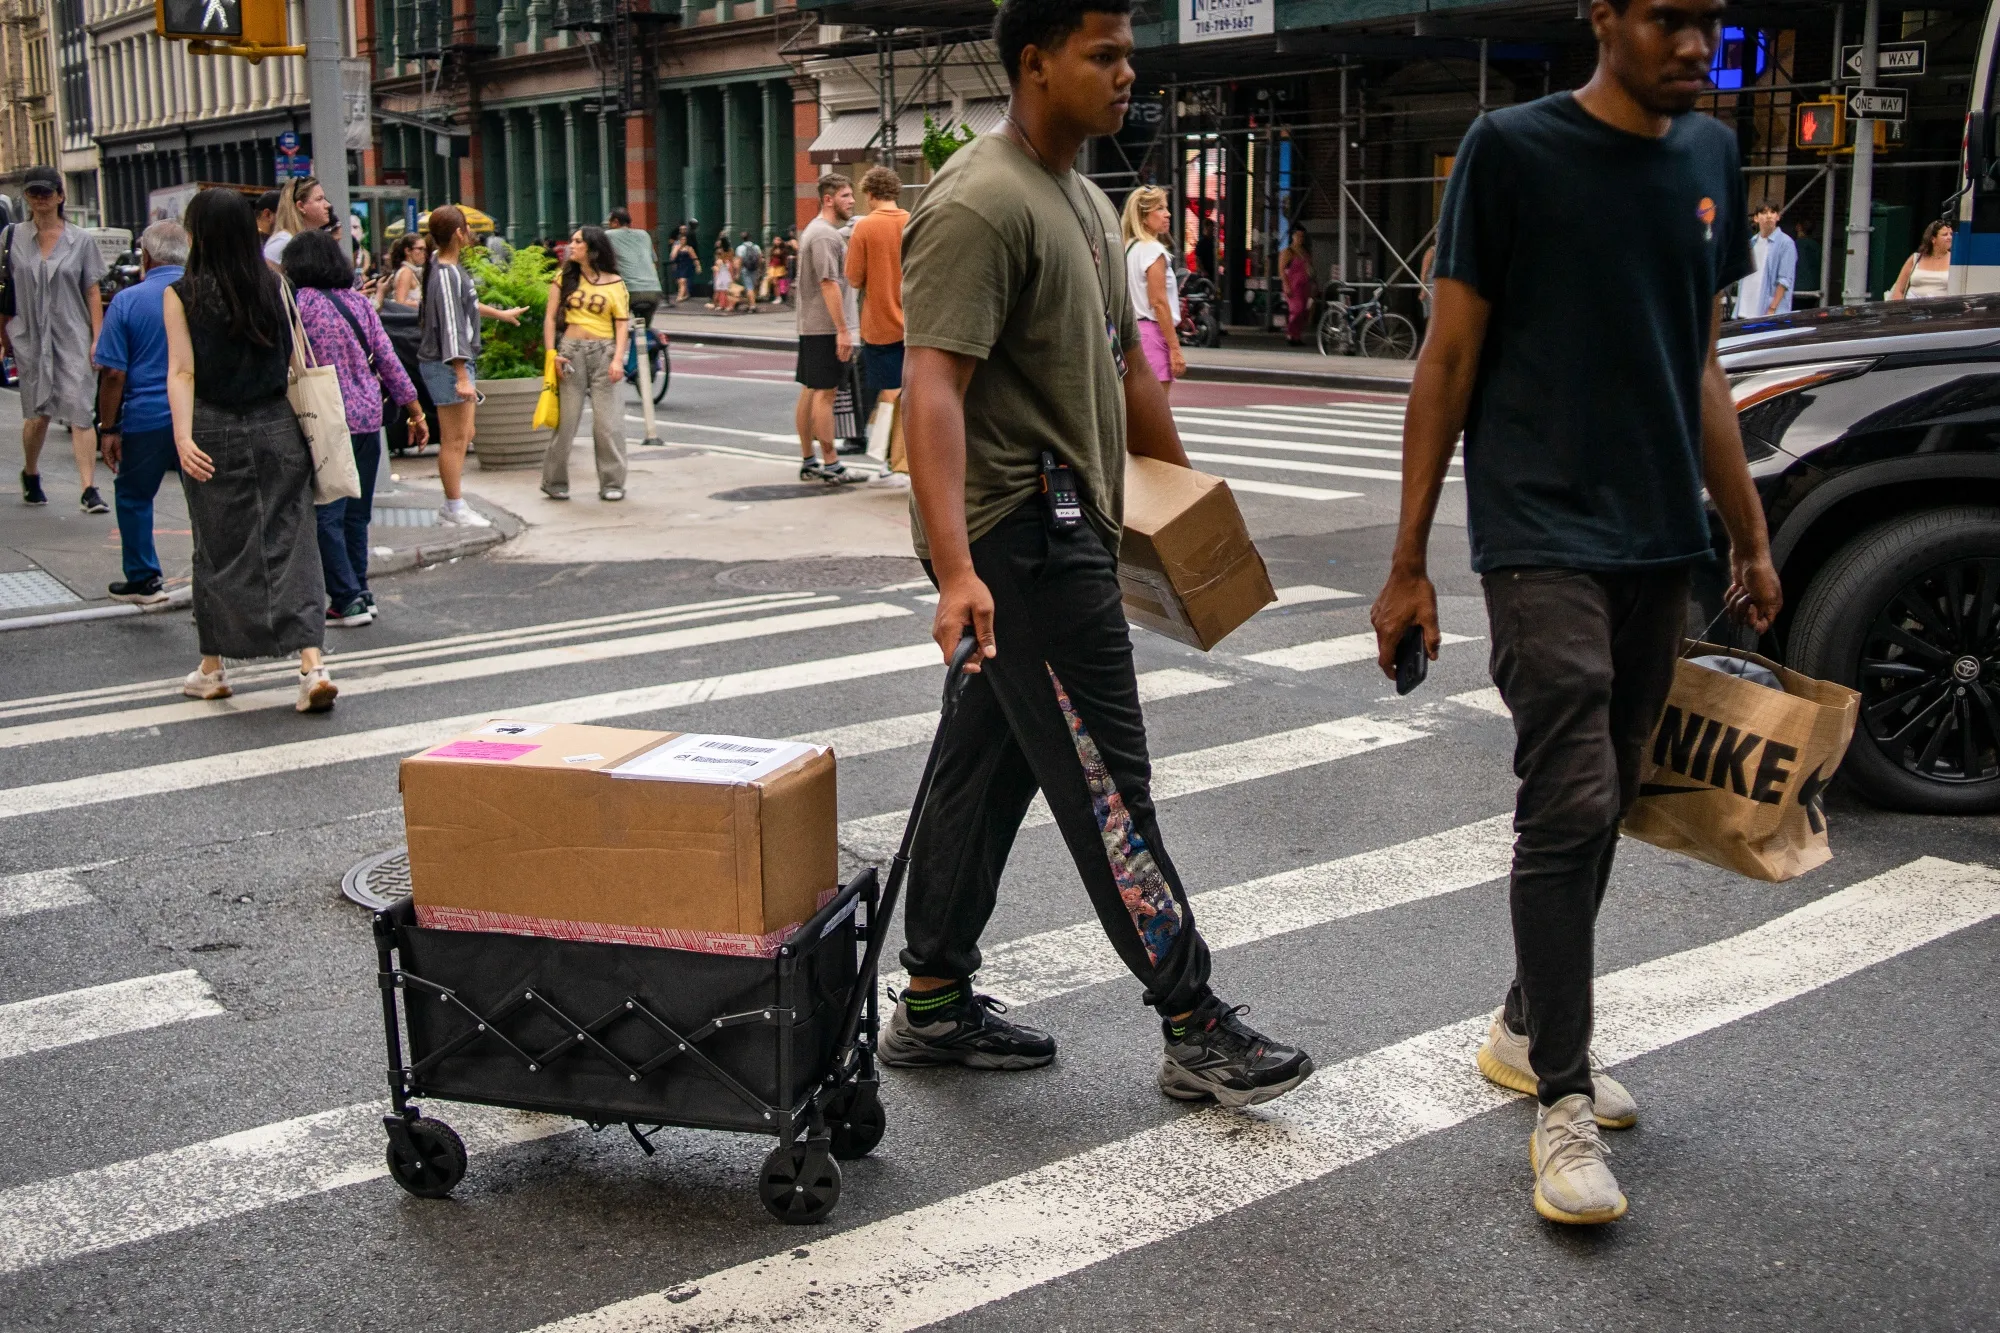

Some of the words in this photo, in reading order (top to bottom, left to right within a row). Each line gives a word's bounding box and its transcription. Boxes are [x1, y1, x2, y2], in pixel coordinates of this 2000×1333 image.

[1888, 52, 1914, 66] WAY
[1855, 97, 1873, 110] ONE
[1880, 98, 1899, 111] WAY
[1652, 704, 1799, 805] NIKE
[713, 941, 747, 950] TAMPER
